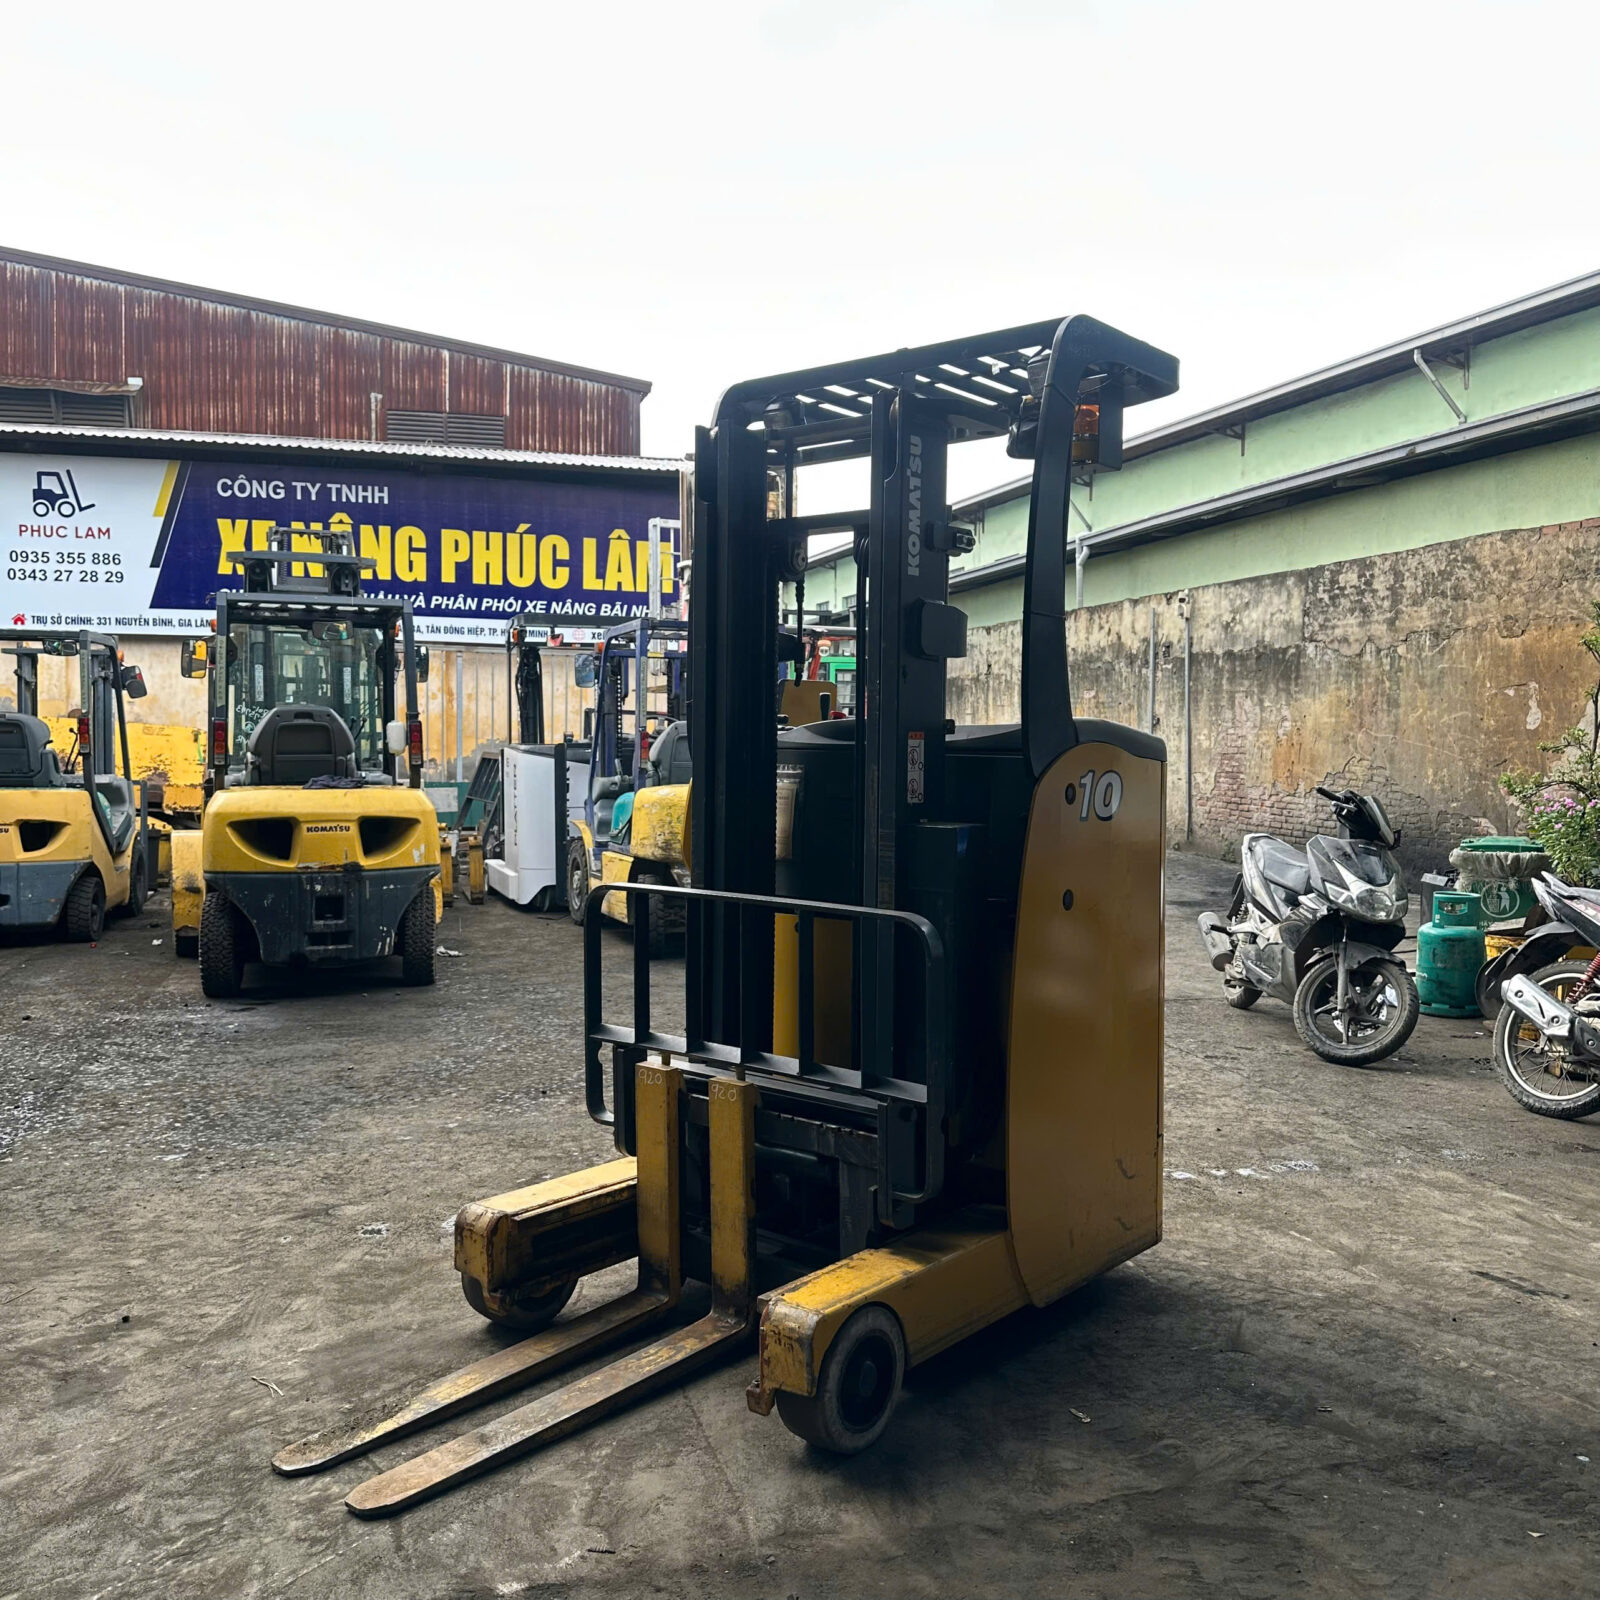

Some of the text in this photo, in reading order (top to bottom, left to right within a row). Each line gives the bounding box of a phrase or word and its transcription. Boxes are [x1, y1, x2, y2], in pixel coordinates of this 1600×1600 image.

[216, 474, 389, 505] CÔNG TY TNHH
[906, 434, 922, 577] KOMATSU
[18, 524, 111, 540] PHUC LAM
[9, 550, 121, 566] 0935 355 886
[440, 523, 570, 590] PHÚC
[7, 568, 124, 583] 0343 27 28 29
[430, 594, 478, 611] PHÂN
[523, 600, 548, 614] XE
[550, 599, 597, 616] NÂNG
[600, 603, 628, 617] BÃI
[31, 615, 48, 627] TRỤ
[64, 613, 95, 626] CHÍNH:
[96, 616, 112, 626] 331
[178, 618, 193, 628] GIA
[1079, 769, 1123, 821] 10
[306, 823, 351, 833] KOMATSU
[638, 1068, 663, 1085] 920
[711, 1083, 737, 1102] 920
